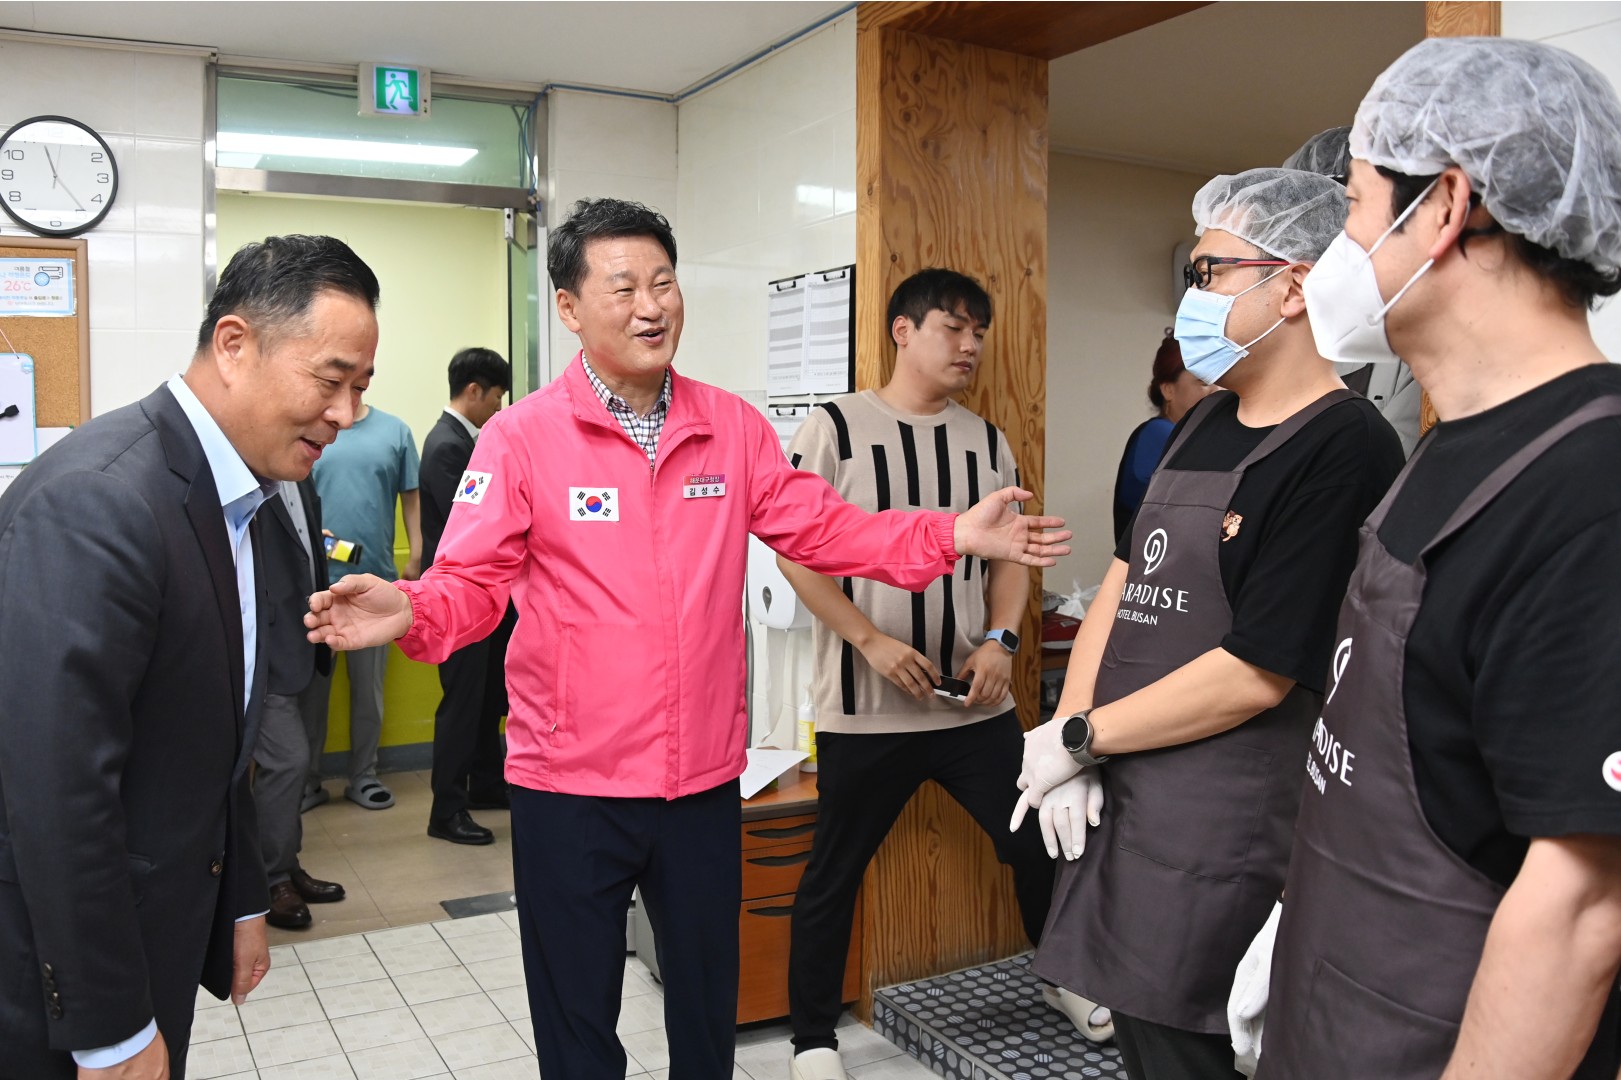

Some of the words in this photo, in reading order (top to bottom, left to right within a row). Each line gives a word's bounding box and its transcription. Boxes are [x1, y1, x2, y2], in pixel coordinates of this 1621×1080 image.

[4, 149, 24, 160] 10
[91, 152, 103, 163] 2
[1, 169, 14, 181] 9
[97, 173, 109, 183] 3
[9, 190, 22, 202] 8
[90, 193, 103, 204] 4
[1121, 582, 1190, 613] ARADISE
[1131, 610, 1158, 626] BUSAN
[1312, 717, 1356, 787] ADISE
